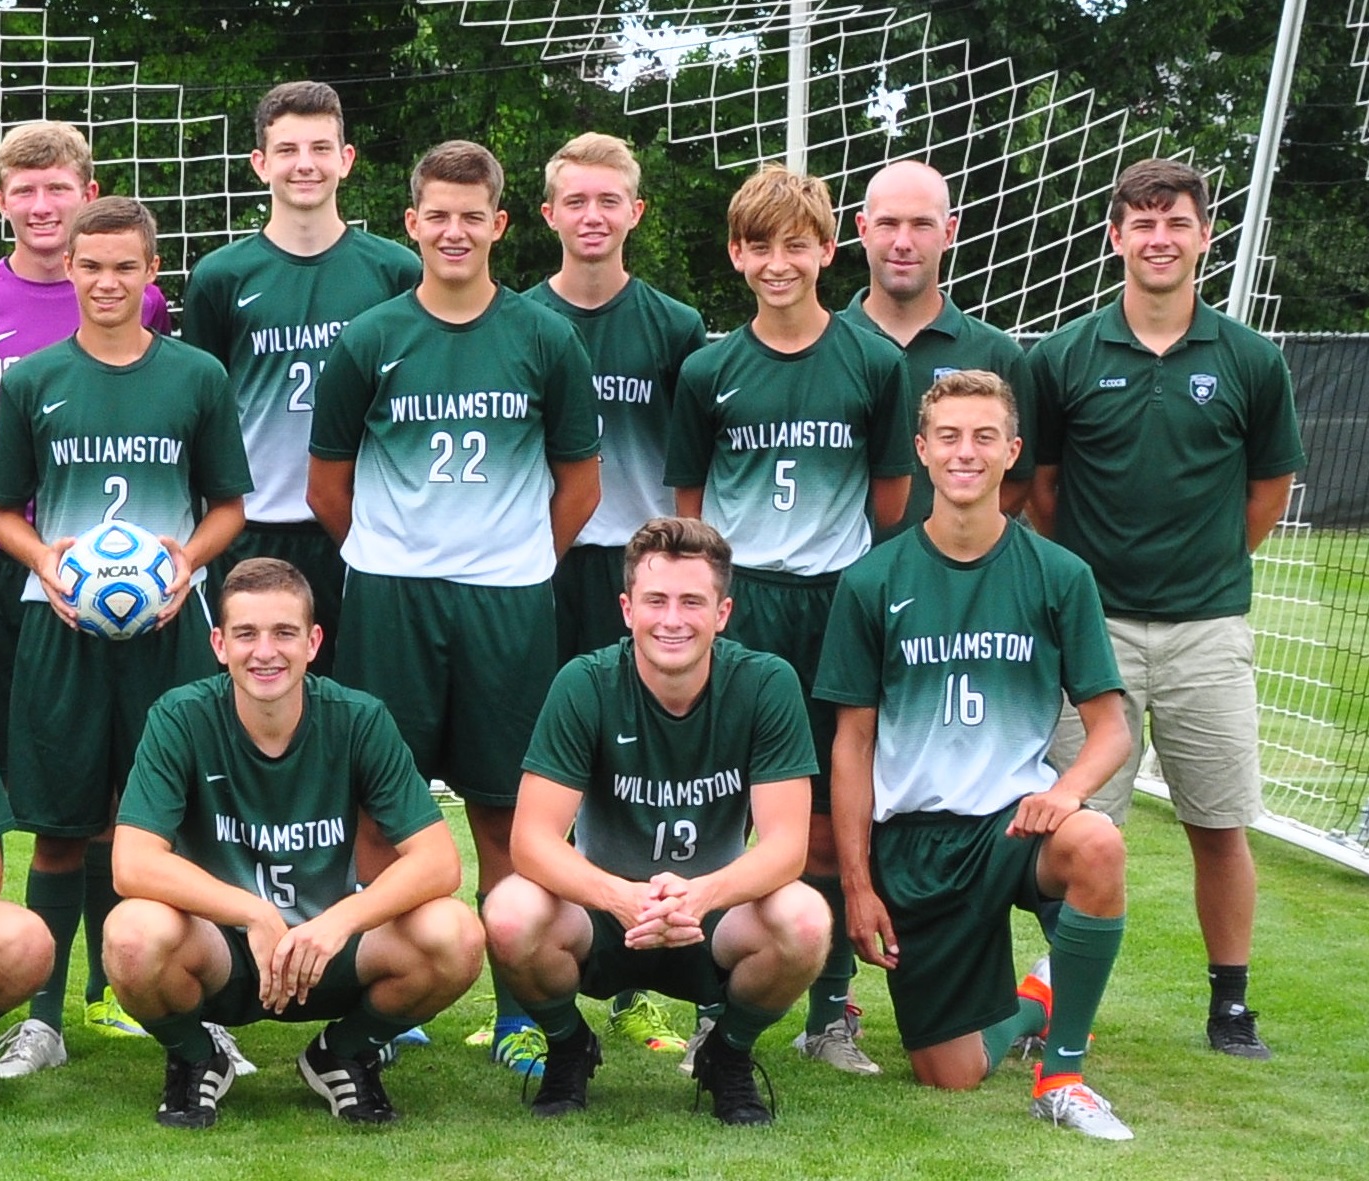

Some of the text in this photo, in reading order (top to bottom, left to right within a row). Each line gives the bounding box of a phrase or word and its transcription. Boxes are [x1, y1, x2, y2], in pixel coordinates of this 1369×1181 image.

[251, 321, 349, 356] WILLIAMS
[391, 392, 529, 423] WILLIAMSTON
[51, 436, 183, 467] WILLIAMSTON
[726, 421, 853, 451] WILLIAMSTON
[428, 430, 488, 483] 22
[102, 475, 129, 525] 2
[773, 459, 797, 511] 5
[96, 565, 139, 579] NCAA
[943, 672, 985, 726] 16
[614, 768, 742, 808] WILLIAMSTON
[215, 813, 345, 853] WLLIAMSTON
[652, 819, 698, 862] 13
[255, 862, 297, 909] 15
